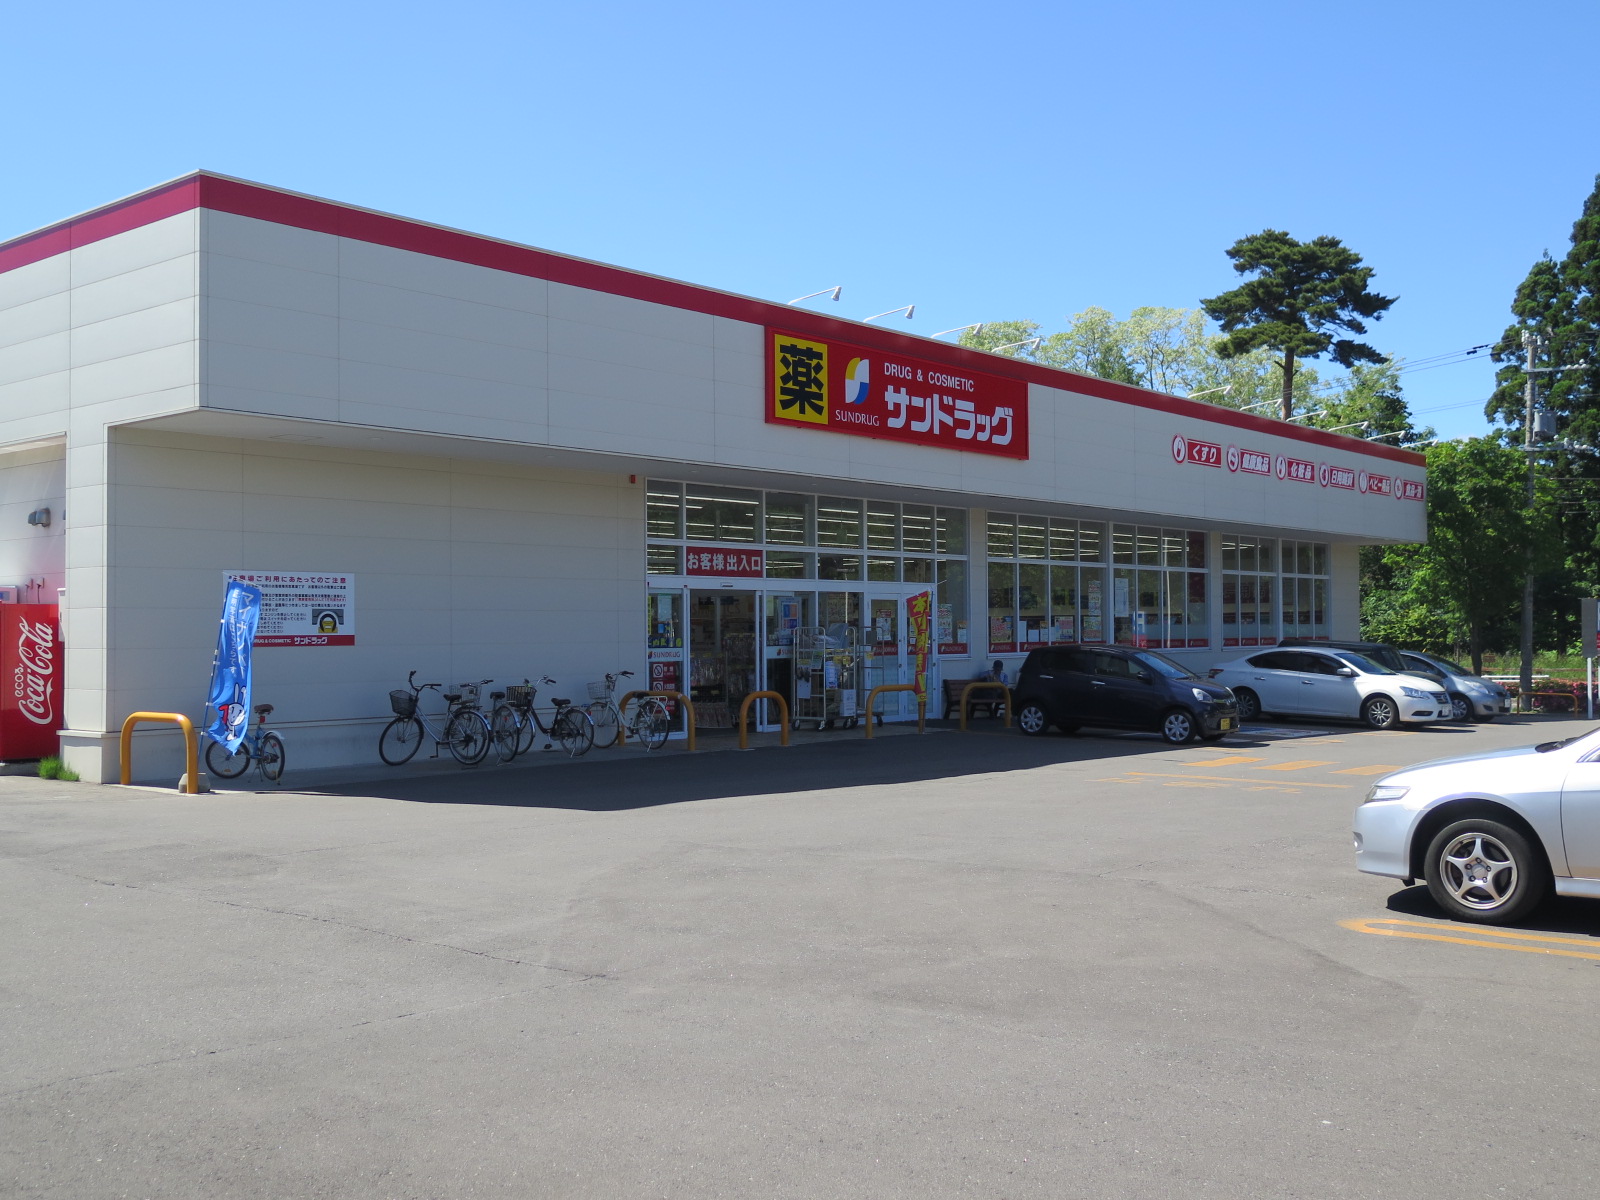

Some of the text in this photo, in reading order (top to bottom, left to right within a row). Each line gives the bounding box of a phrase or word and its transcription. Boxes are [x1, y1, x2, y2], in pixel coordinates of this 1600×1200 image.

[780, 344, 825, 416] 薬
[884, 362, 975, 392] DRUG & COSMETIC
[835, 409, 880, 427] SUNDRUG
[884, 384, 1014, 446] サンドラッグ
[1192, 445, 1217, 463] くすり
[1290, 463, 1312, 479] 化粧品
[687, 553, 761, 571] お客様出入口
[18, 616, 53, 725] Coca-Cola
